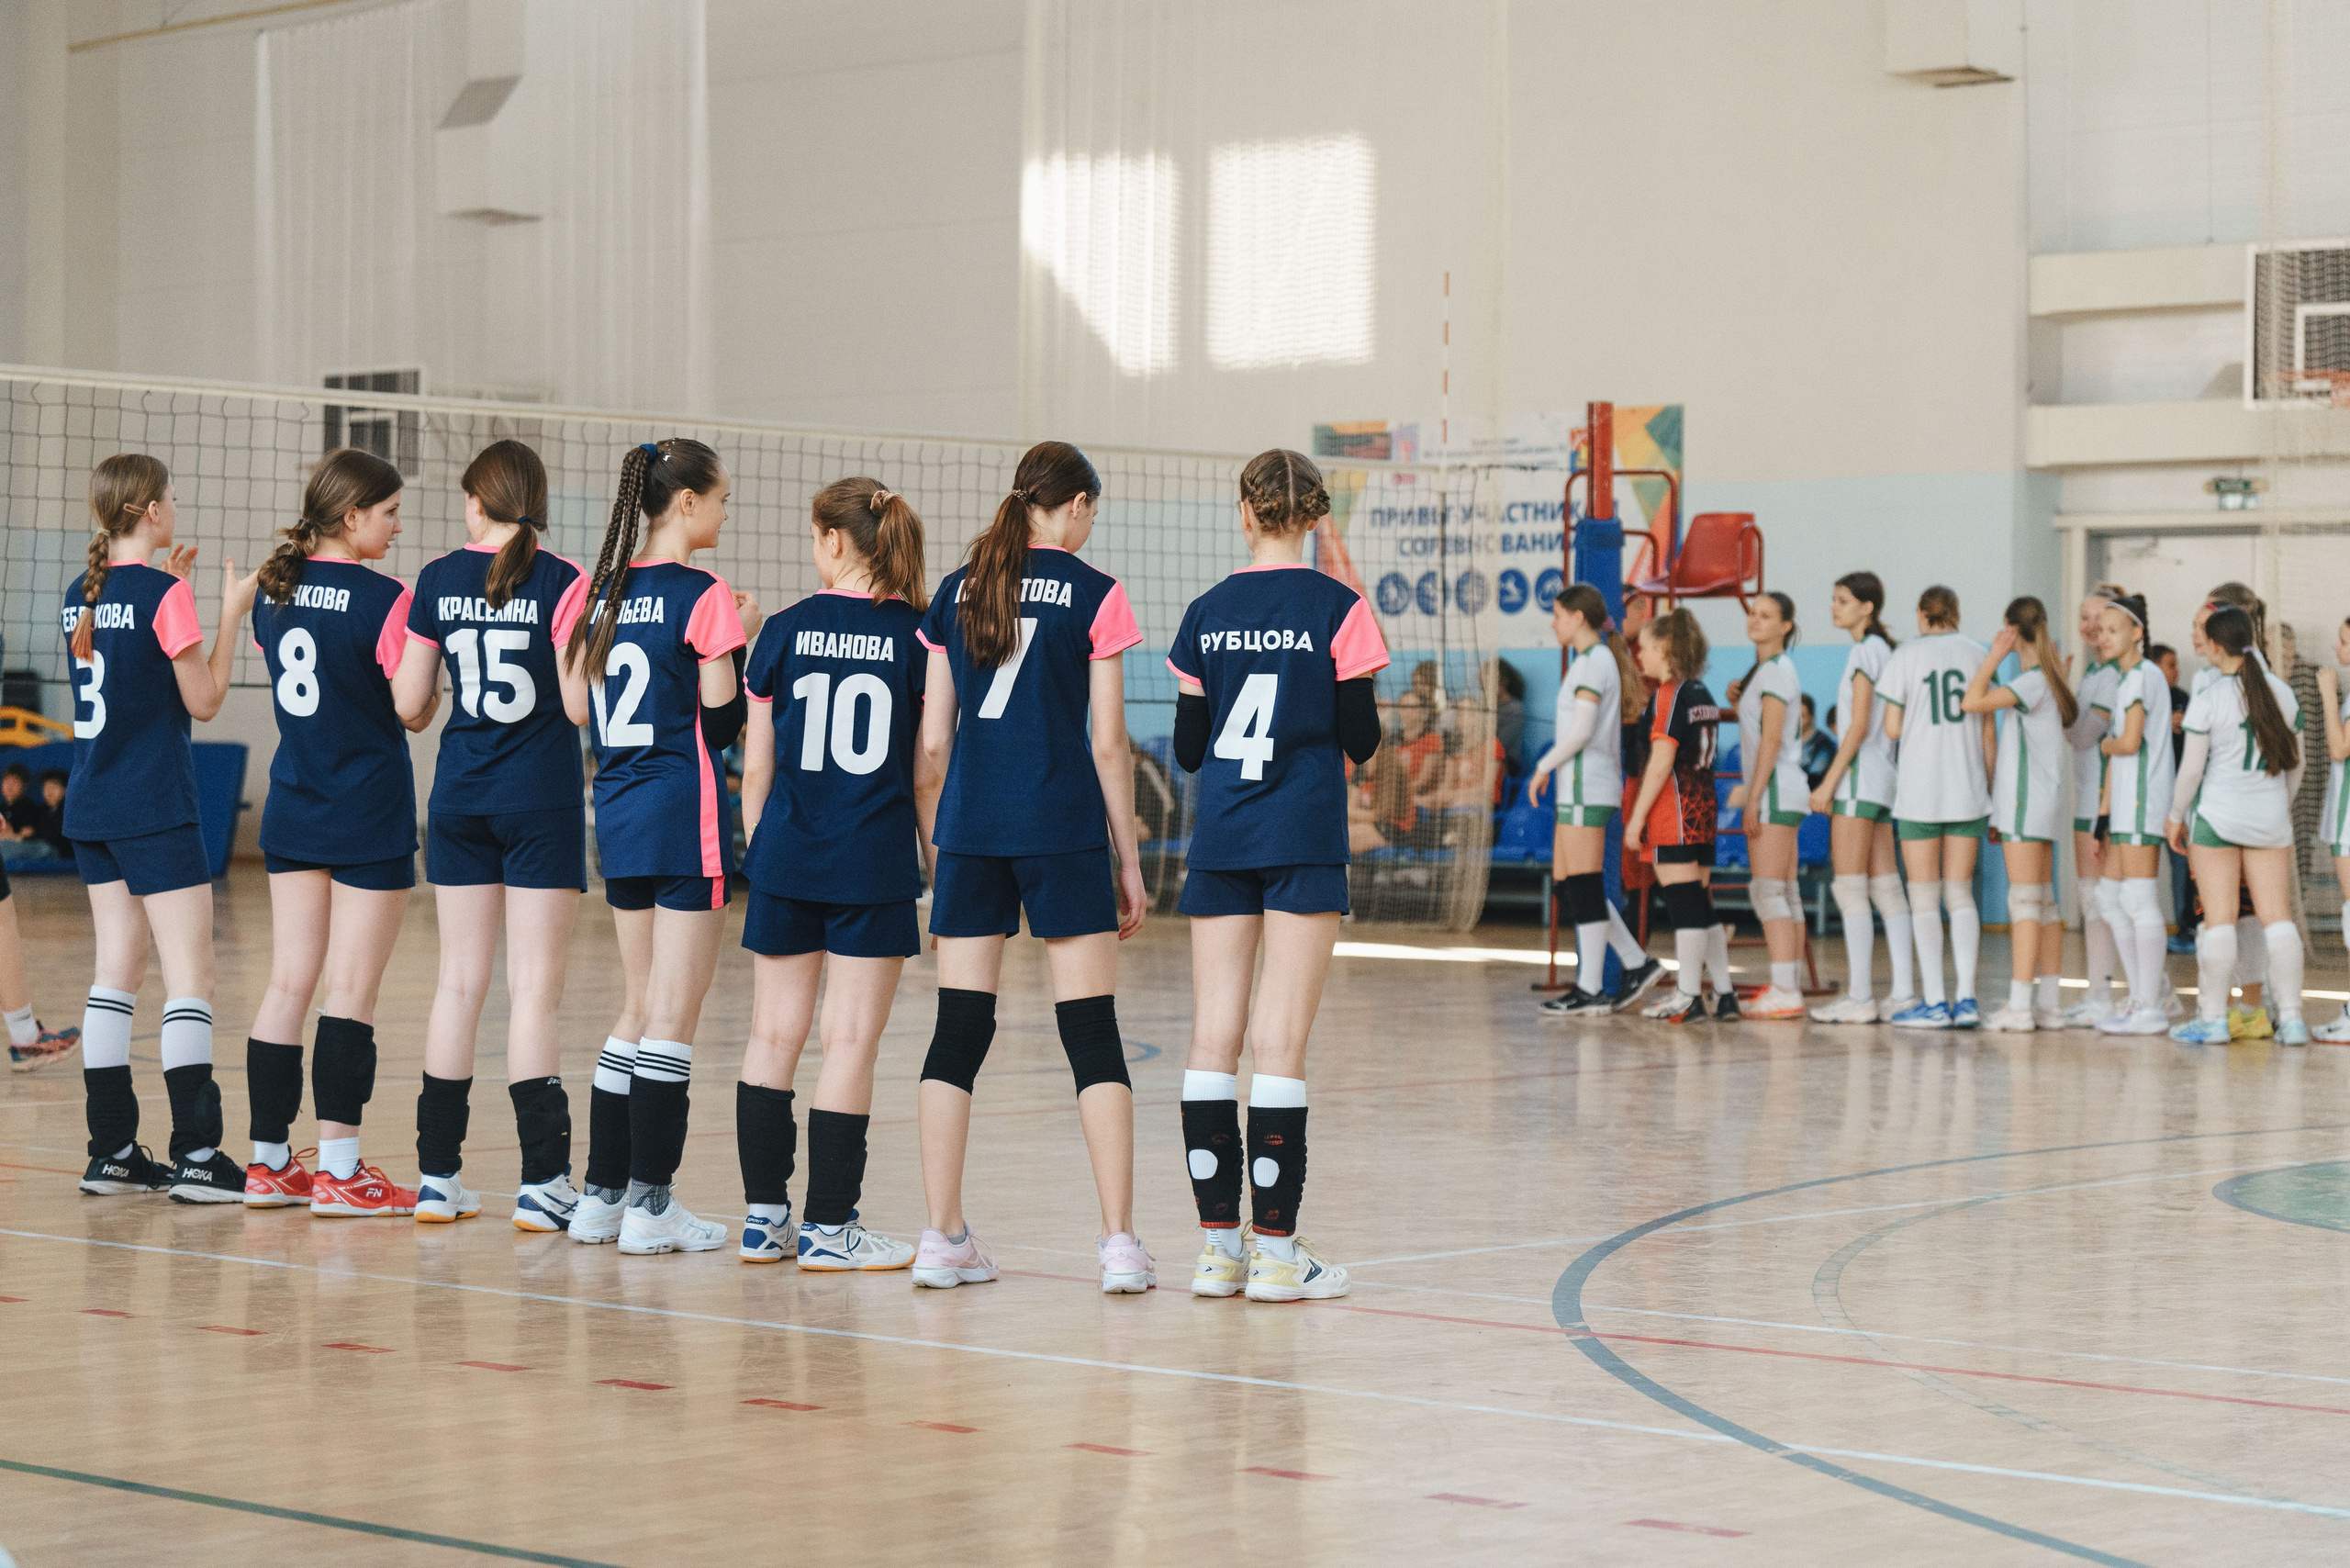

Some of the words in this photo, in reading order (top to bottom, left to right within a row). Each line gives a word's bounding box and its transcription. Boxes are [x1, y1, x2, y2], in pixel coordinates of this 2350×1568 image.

[795, 631, 894, 662] ИВАНОВА
[978, 617, 1038, 719] 7
[1200, 630, 1314, 654] РУБЦОВА
[73, 650, 106, 739] 3
[277, 627, 319, 717] 8
[445, 628, 536, 723] 15
[1922, 669, 1965, 725] 16
[792, 672, 892, 775] 10
[1214, 673, 1278, 780] 4
[2239, 716, 2268, 771] 1
[102, 1164, 129, 1178] HOKA
[182, 1167, 213, 1182] HOKA
[365, 1187, 383, 1197] FN
